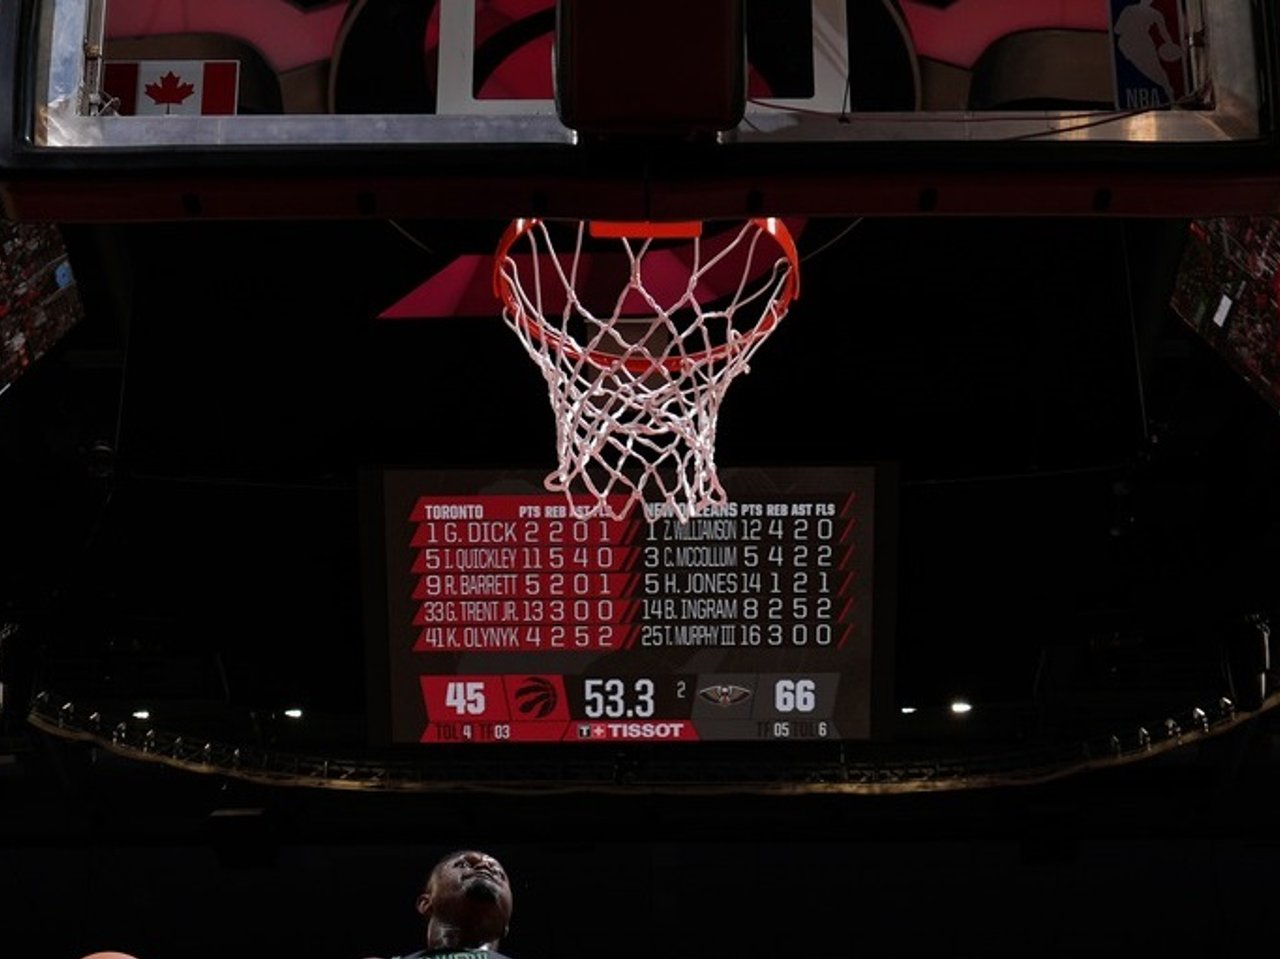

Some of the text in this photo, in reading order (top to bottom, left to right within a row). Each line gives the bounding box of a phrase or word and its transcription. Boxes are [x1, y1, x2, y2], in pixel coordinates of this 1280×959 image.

[1125, 87, 1161, 108] NBA
[425, 505, 484, 519] TORONTO
[519, 505, 567, 518] PTS REB
[741, 504, 835, 516] PTS REB AST FLS
[427, 522, 438, 543] 1
[444, 522, 462, 543] G.
[469, 522, 517, 543] DICK
[525, 522, 539, 543] 2
[549, 522, 563, 543] 2
[599, 522, 611, 543] 1
[646, 519, 658, 540] 1
[741, 519, 761, 540] 12
[768, 519, 783, 540] 4
[794, 519, 808, 540] 2
[426, 548, 441, 569] 5
[456, 548, 517, 569] QUICKLEY
[523, 548, 542, 569] 11
[550, 548, 564, 569] 5
[573, 548, 588, 569] 4
[645, 546, 659, 567] 3
[744, 546, 759, 567] 5
[768, 546, 783, 567] 4
[794, 546, 808, 567] 2
[817, 546, 832, 567] 2
[426, 574, 441, 595] 9
[445, 574, 458, 595] R.
[460, 574, 518, 595] BARRETT
[525, 574, 540, 595] 5
[550, 574, 564, 595] 2
[600, 574, 611, 595] 1
[645, 573, 830, 593] 5 H. JONES 14 1 2 1
[425, 601, 444, 621] 33
[460, 601, 499, 621] TRENT
[501, 601, 519, 621] JR.
[523, 601, 543, 621] 13
[550, 601, 564, 621] 3
[642, 599, 662, 620] 14
[681, 599, 738, 620] INGRAM
[743, 599, 759, 620] 8
[768, 599, 783, 620] 2
[793, 599, 808, 620] 5
[817, 599, 831, 620] 2
[426, 627, 613, 647] 41 K. OLYNYK 4 2 5 2
[642, 625, 663, 646] 25
[675, 625, 719, 646] MURPHY
[740, 625, 761, 646] 16
[768, 625, 783, 646] 3
[445, 681, 485, 715] 45
[584, 678, 655, 719] 53.3
[676, 679, 687, 699] 2
[774, 679, 816, 712] 66
[463, 724, 472, 739] 4
[494, 724, 510, 739] 03
[608, 723, 684, 738] TISSOT
[773, 722, 790, 737] 05
[818, 722, 827, 737] 6
